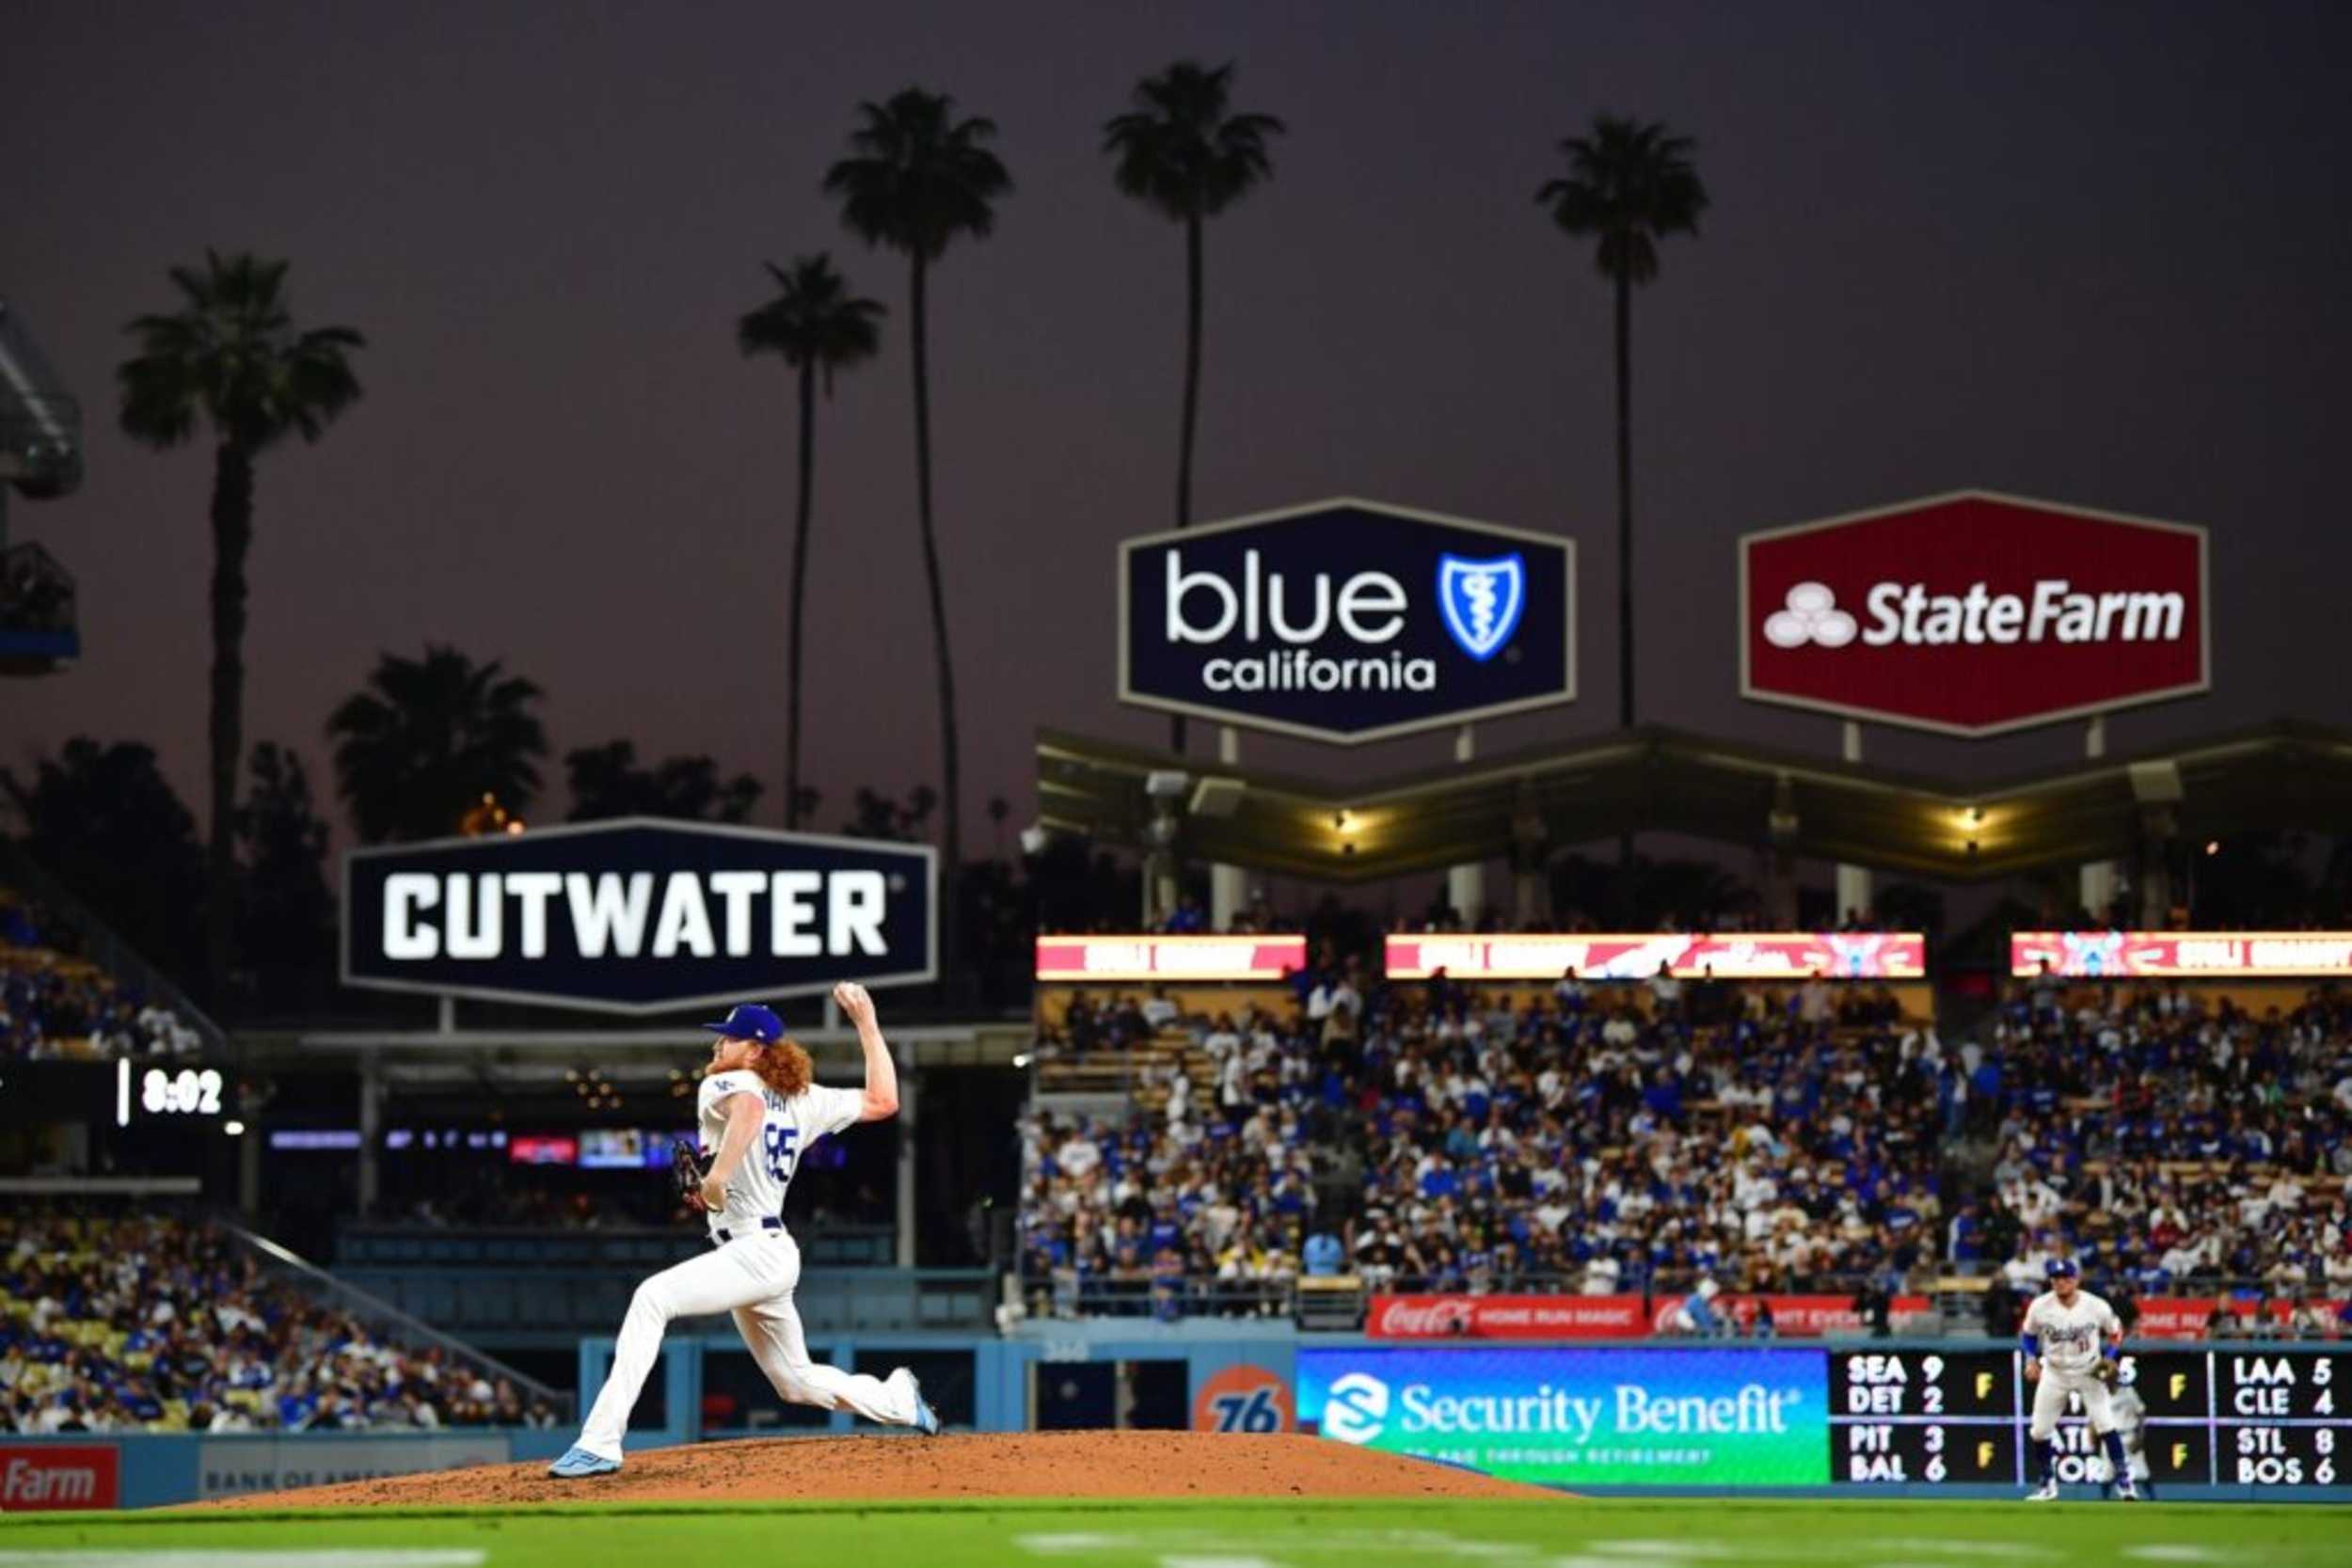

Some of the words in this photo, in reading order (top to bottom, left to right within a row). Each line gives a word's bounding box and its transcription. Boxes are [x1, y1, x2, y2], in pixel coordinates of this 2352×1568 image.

[1167, 549, 1408, 643] blue
[1203, 650, 1436, 691] california
[383, 871, 888, 958] CUTWATER
[142, 1069, 222, 1114] 8:02
[1848, 1356, 1907, 1383] SEA
[1922, 1356, 1944, 1383] 9
[2233, 1357, 2296, 1385] LAA
[2312, 1357, 2332, 1385] 5
[1977, 1372, 1993, 1399] F
[2169, 1373, 2185, 1401] F
[1214, 1385, 1278, 1433] 76
[1849, 1386, 1904, 1413] DET
[1923, 1386, 1944, 1413] 2
[2233, 1387, 2290, 1415] CLE
[2313, 1388, 2335, 1415] 4
[1401, 1384, 1602, 1445] Security
[1615, 1384, 1788, 1433] Benefit
[1850, 1425, 1893, 1452] PIT
[1924, 1425, 1945, 1452] 3
[2236, 1428, 2286, 1454] STL
[2315, 1428, 2334, 1454] 8
[1851, 1455, 1907, 1481] BAL
[1925, 1455, 1947, 1482] 6
[1978, 1442, 1994, 1468] F
[2171, 1443, 2187, 1469] F
[4, 1460, 96, 1501] Farm
[206, 1471, 276, 1492] BANK
[2237, 1457, 2303, 1484] BOS
[2314, 1457, 2335, 1484] 6
